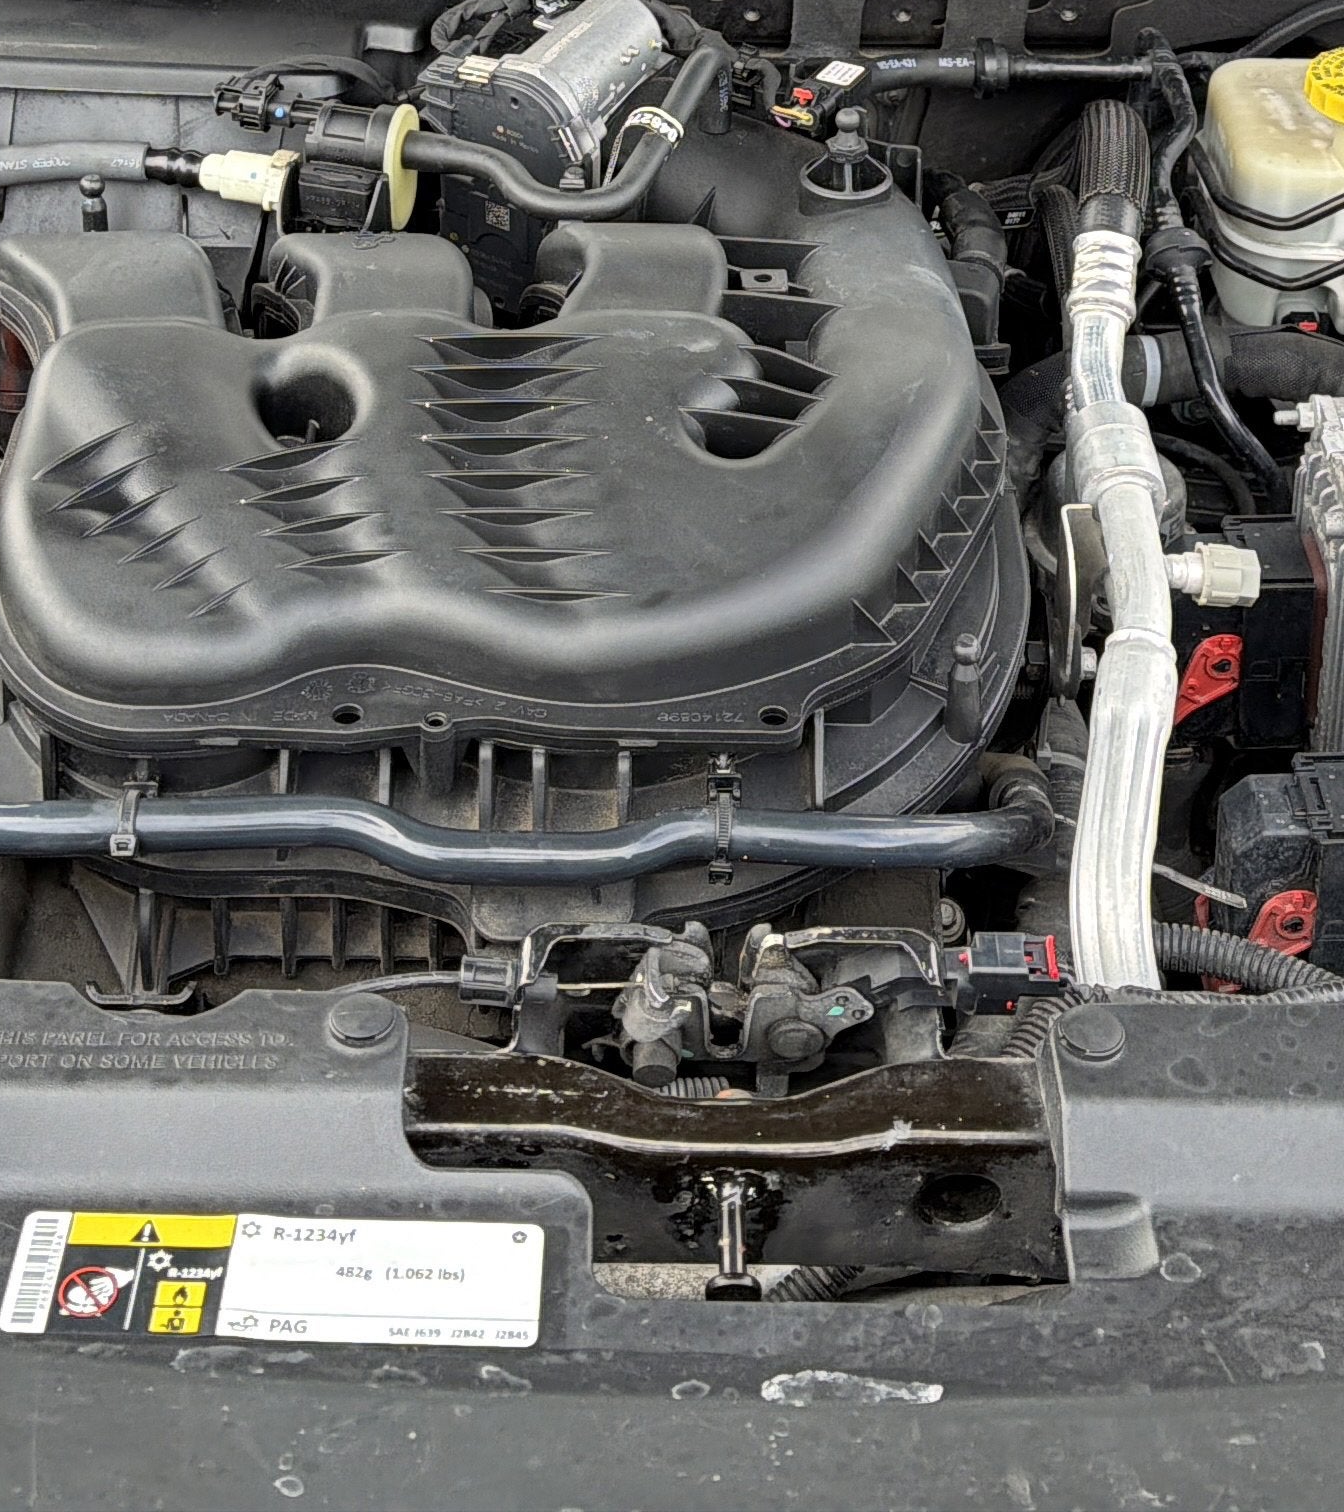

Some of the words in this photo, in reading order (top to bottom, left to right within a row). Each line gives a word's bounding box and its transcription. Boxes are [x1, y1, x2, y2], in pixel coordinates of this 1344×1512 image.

[41, 1031, 111, 1047] PANEL
[117, 1031, 163, 1047] FOR
[166, 1030, 253, 1047] ACCESS
[60, 1053, 92, 1069] ON
[99, 1053, 167, 1070] SOME
[273, 1226, 357, 1245] R-1234yf
[336, 1266, 373, 1281] 482g
[385, 1267, 434, 1281] (1.062
[437, 1268, 465, 1282] lbs)
[269, 1318, 308, 1335] PAG
